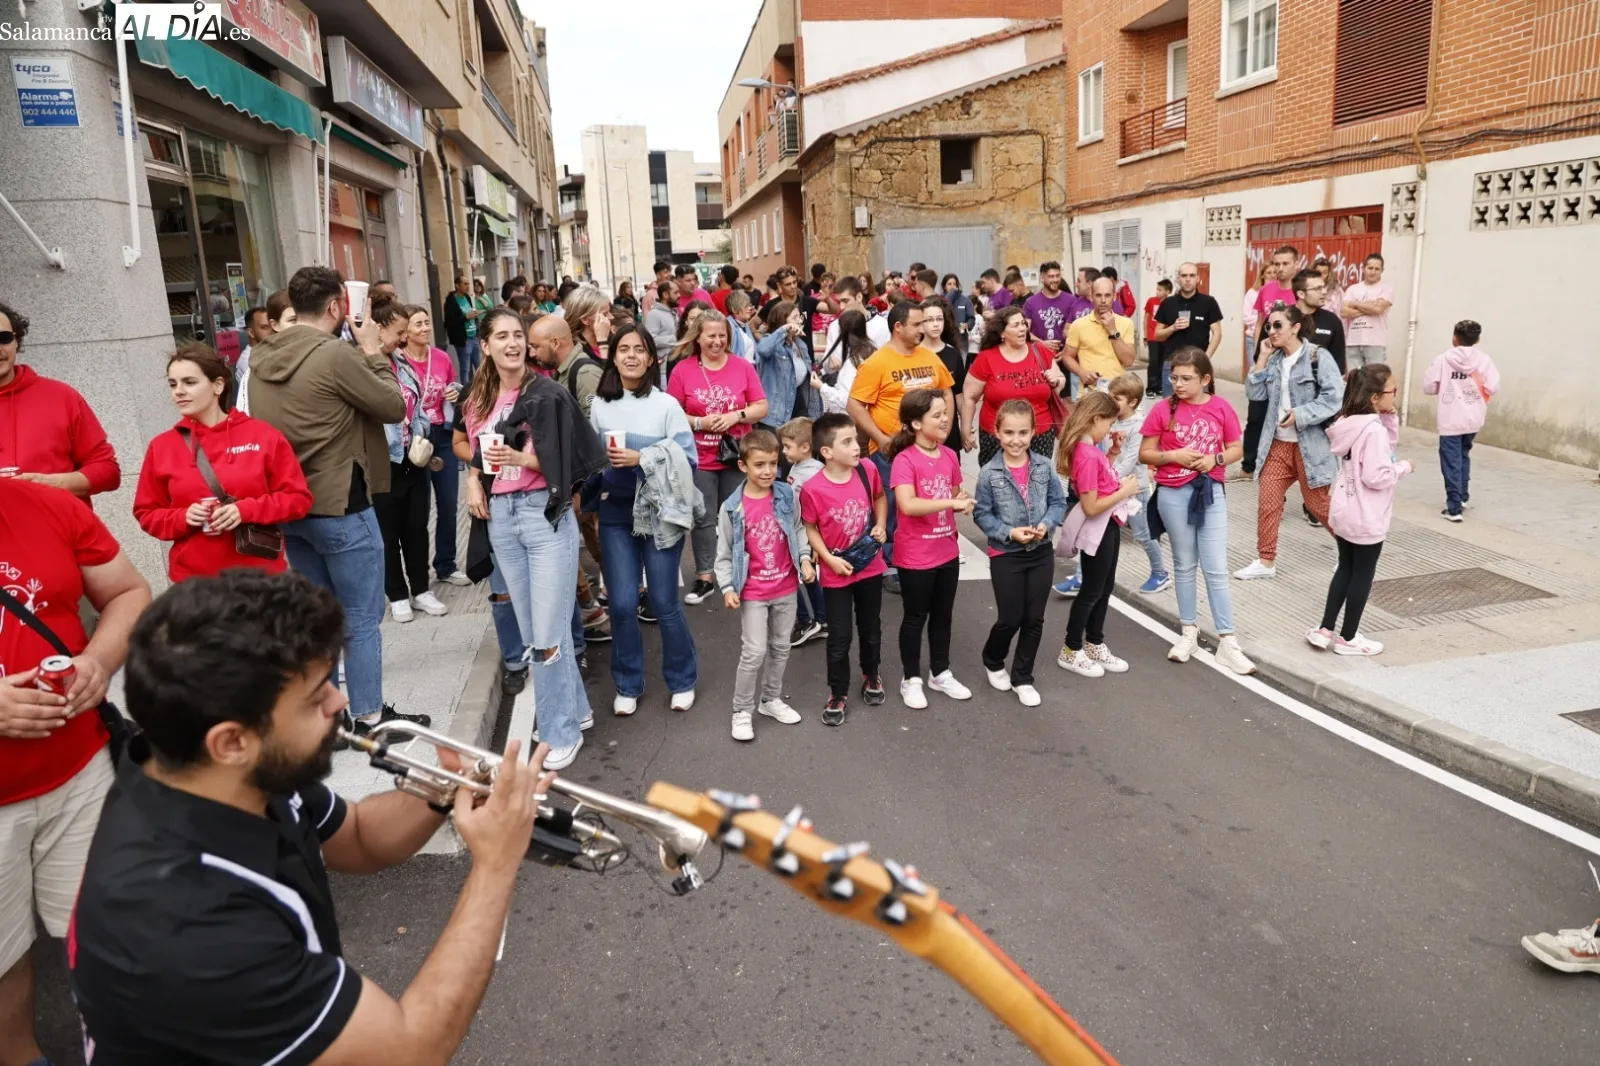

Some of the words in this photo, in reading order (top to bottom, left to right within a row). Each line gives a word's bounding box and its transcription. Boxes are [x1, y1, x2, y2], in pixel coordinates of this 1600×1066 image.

[14, 63, 51, 74] tyco
[20, 92, 60, 101] Alarma
[22, 108, 39, 116] 902
[41, 108, 57, 116] 444
[59, 108, 76, 116] 440
[891, 368, 912, 383] SAN
[911, 365, 936, 380] DIEGO
